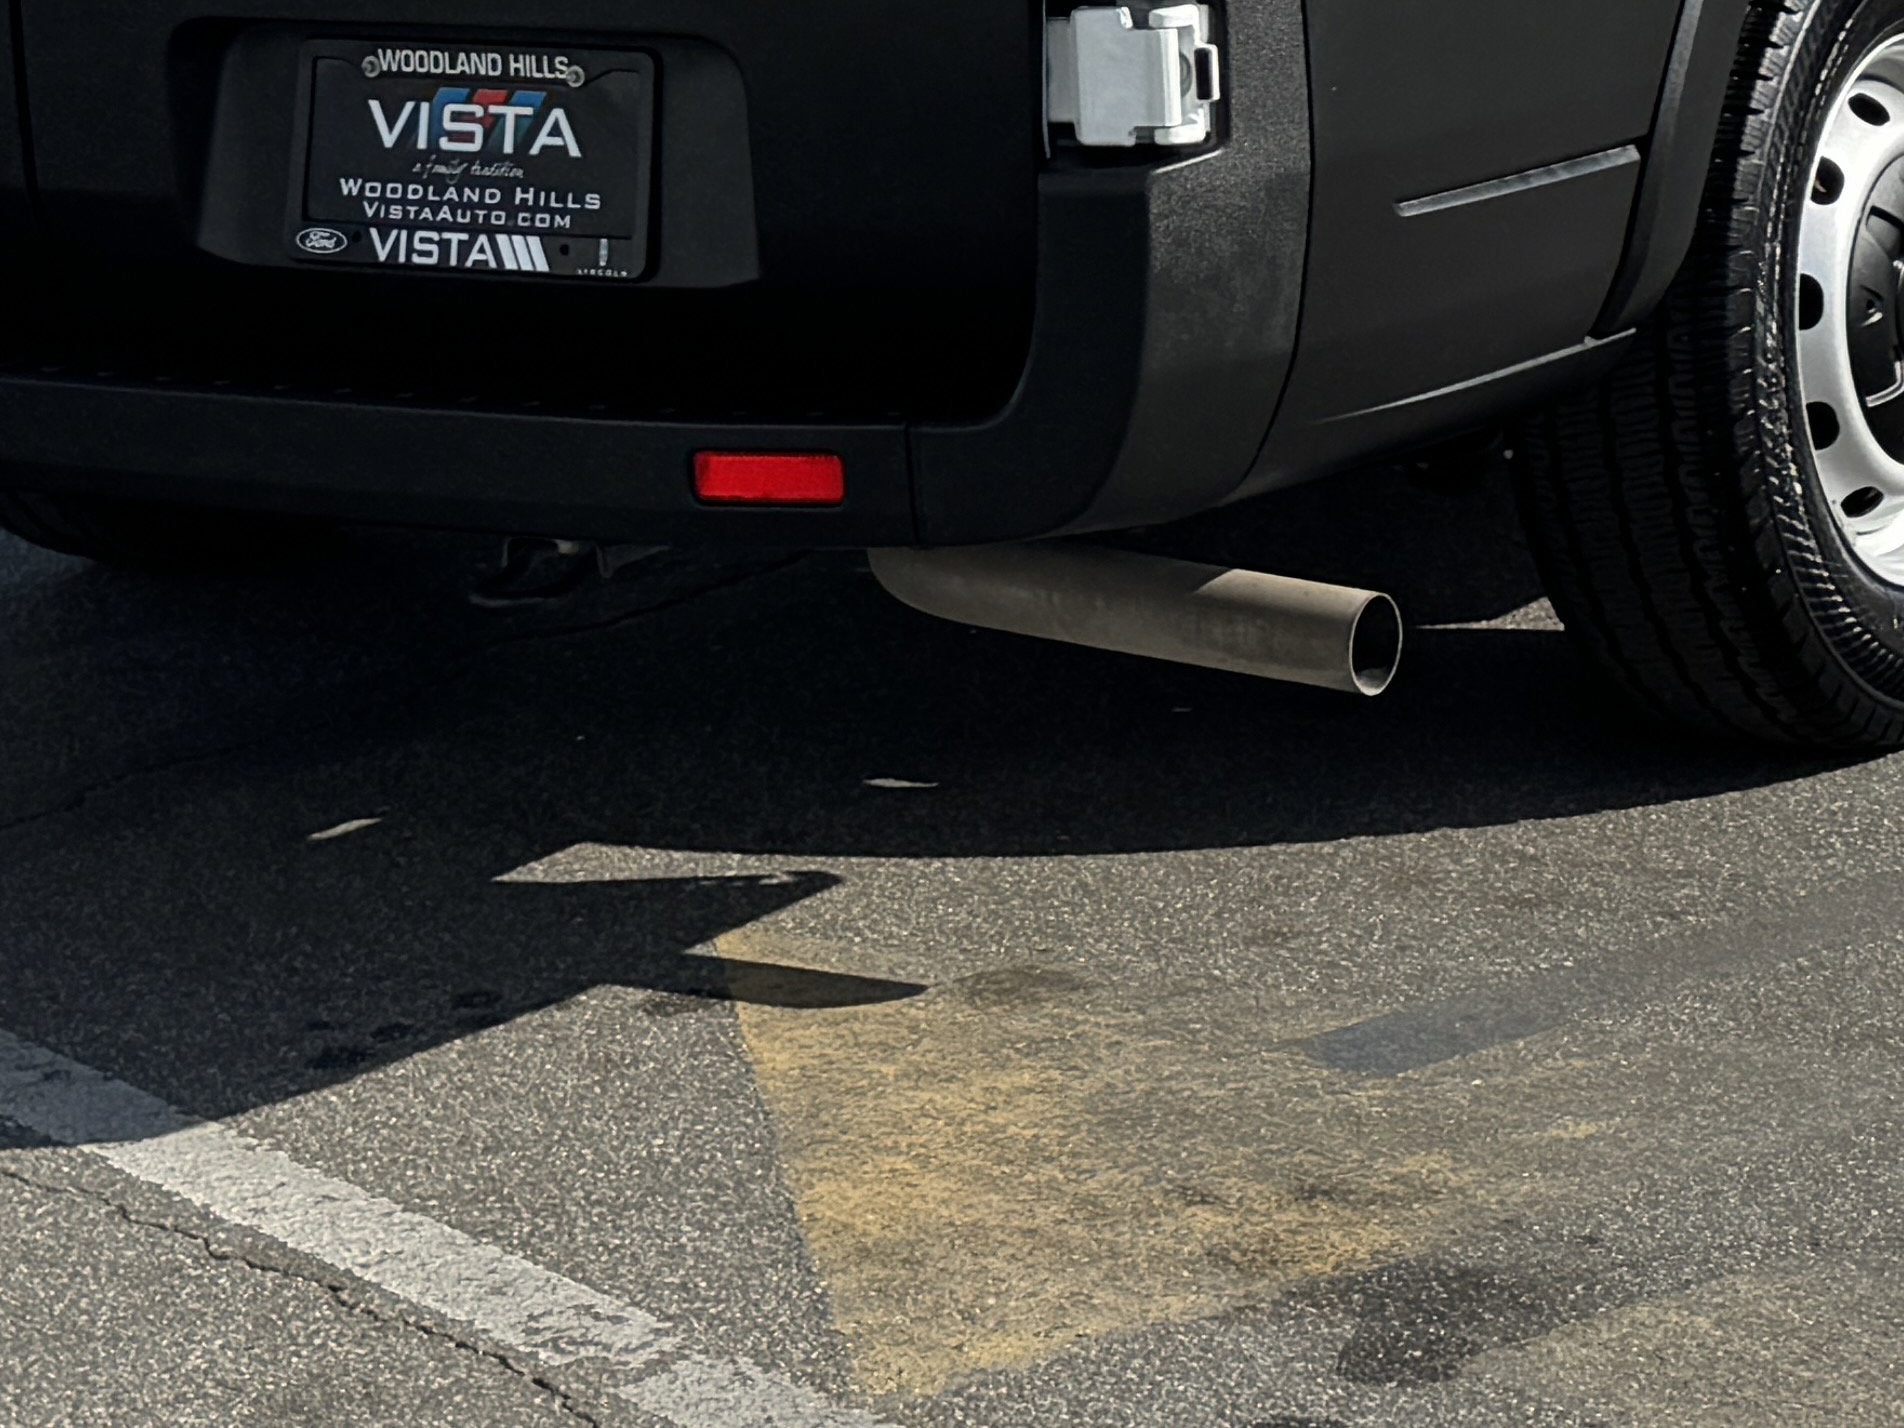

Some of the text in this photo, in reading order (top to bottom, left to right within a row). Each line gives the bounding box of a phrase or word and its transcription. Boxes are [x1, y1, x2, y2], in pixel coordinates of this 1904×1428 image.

[377, 48, 569, 79] WOODLAND HILLS
[368, 99, 582, 157] VISTA
[339, 177, 601, 210] WOODLAND HILLS
[369, 227, 498, 268] VISTA
